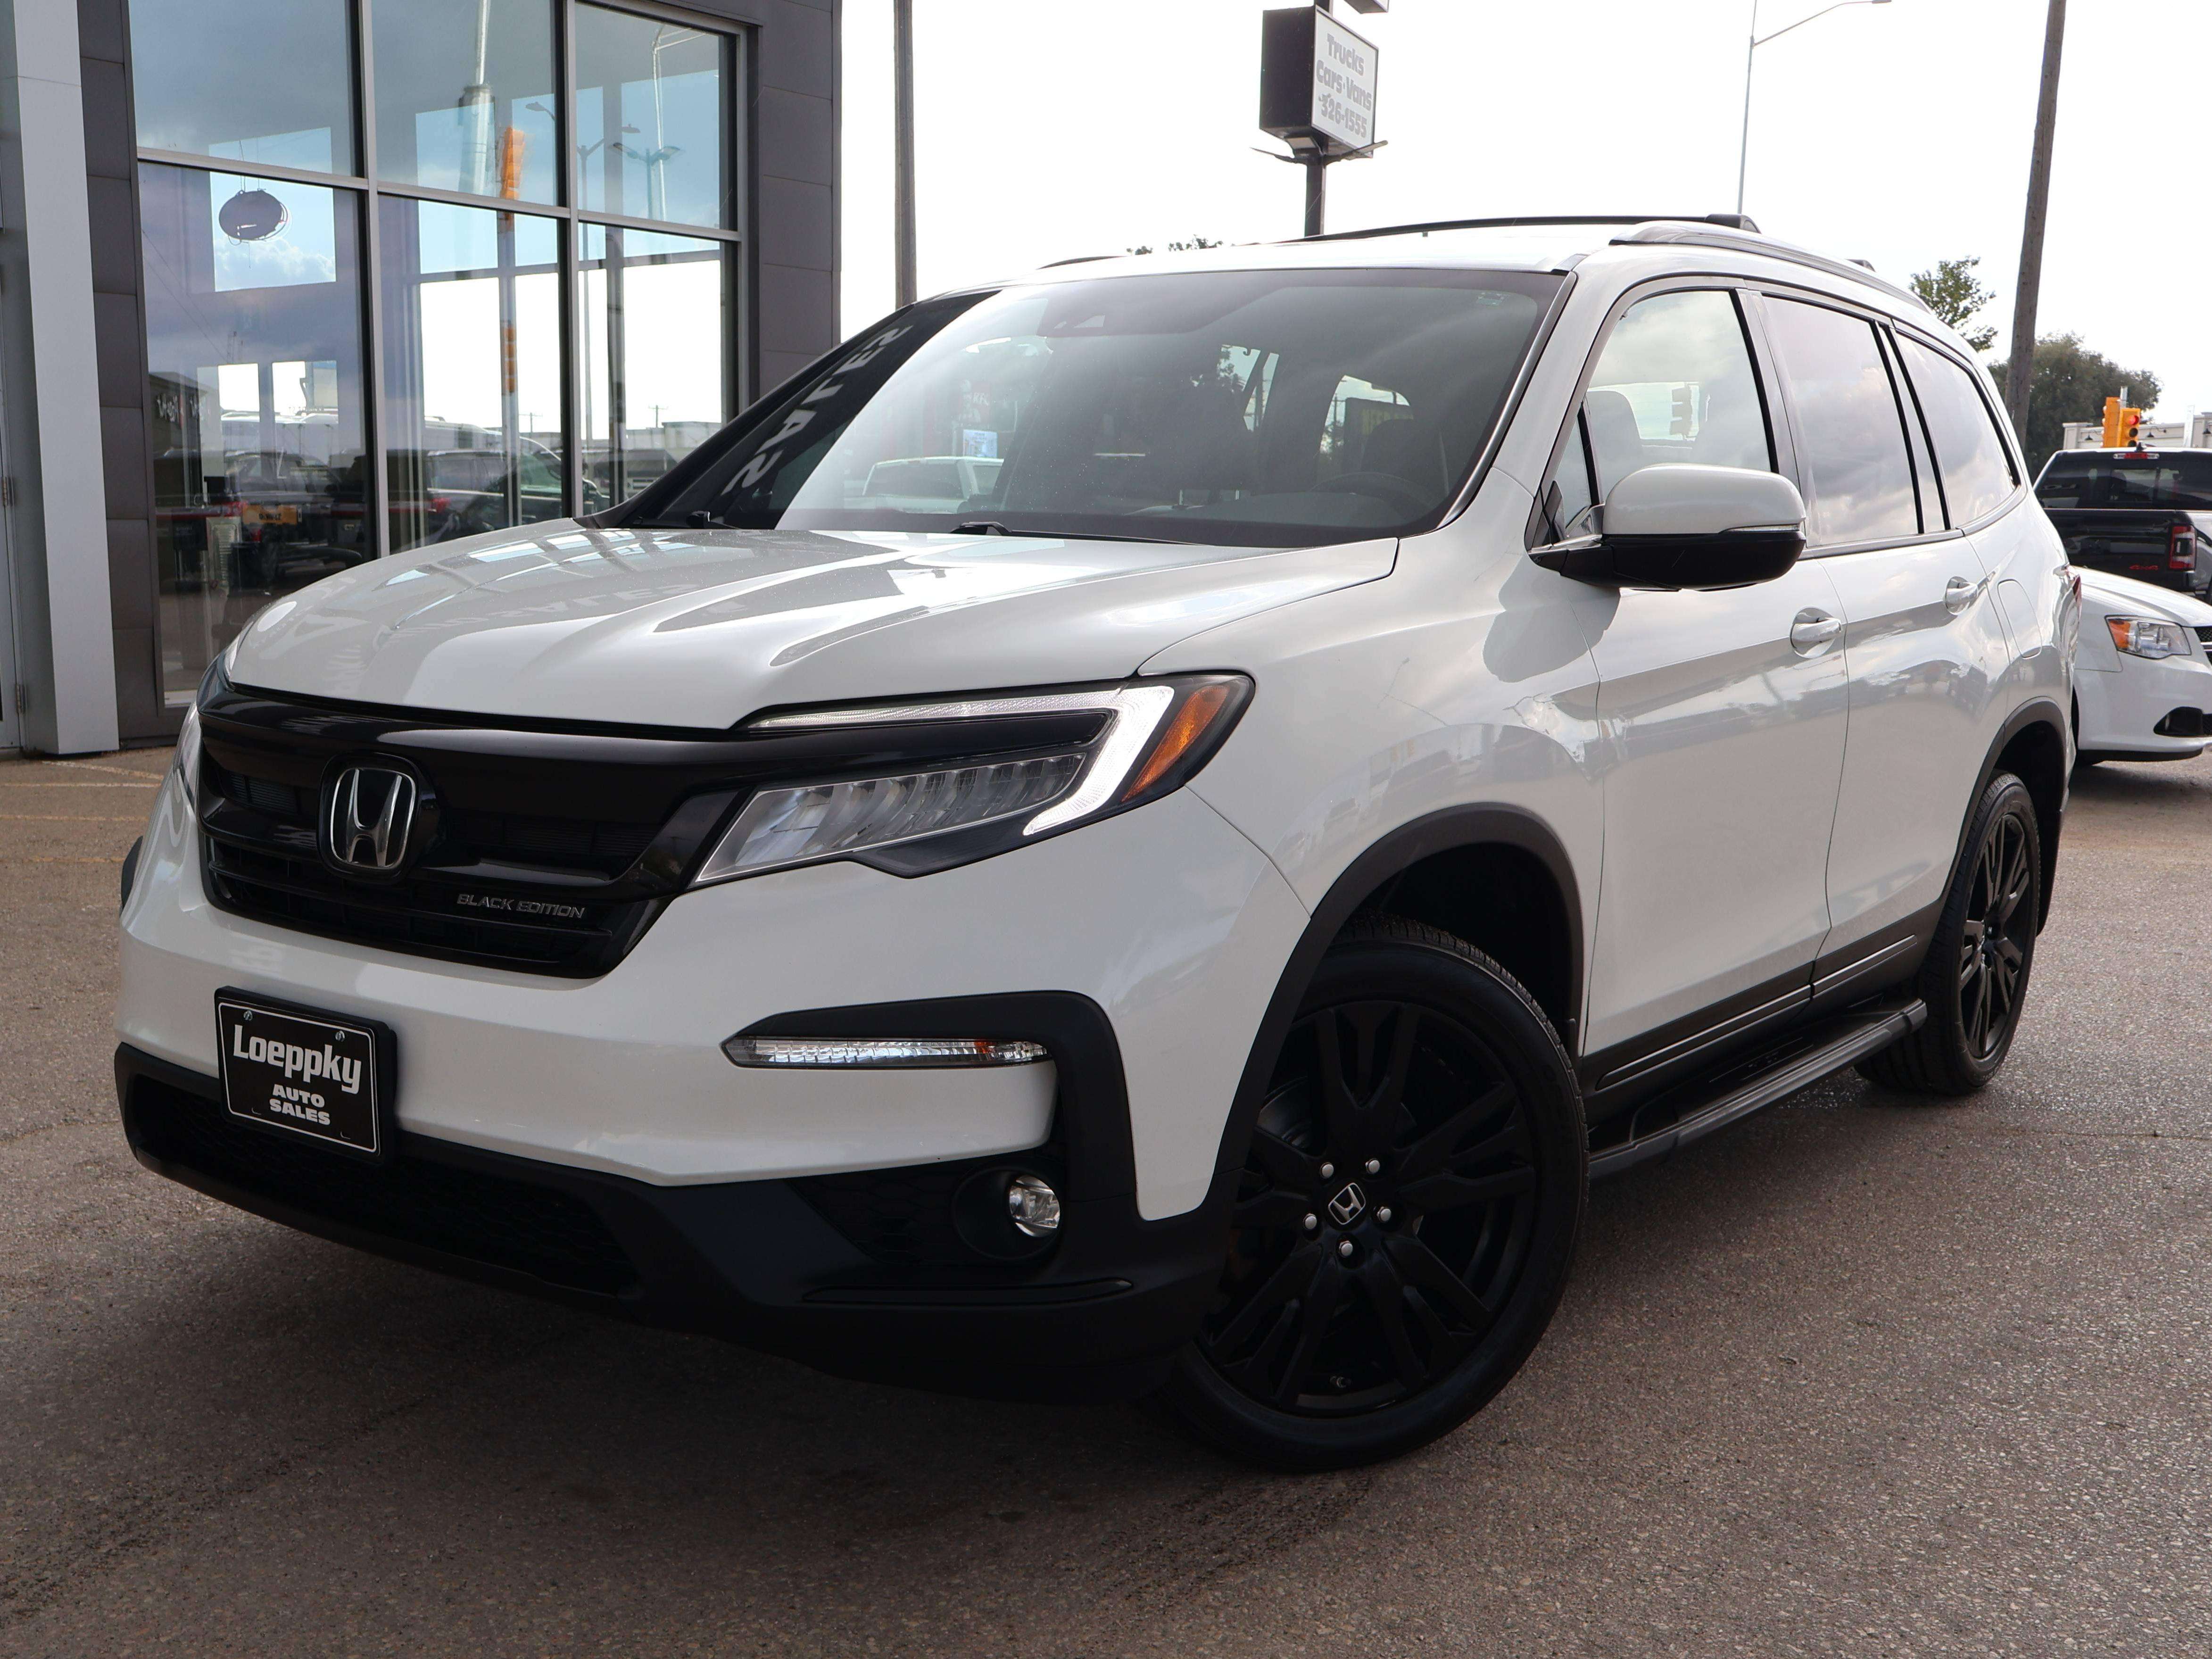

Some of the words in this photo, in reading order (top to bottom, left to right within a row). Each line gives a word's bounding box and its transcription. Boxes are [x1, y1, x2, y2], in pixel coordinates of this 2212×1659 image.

[1327, 33, 1364, 76] Trucks
[1321, 98, 1367, 138] 326-1555
[457, 894, 514, 910] BLACK
[516, 901, 585, 919] EDITION
[233, 1024, 362, 1094] Loeppky
[269, 1098, 331, 1126] SALES
[273, 1084, 325, 1108] AUTO
